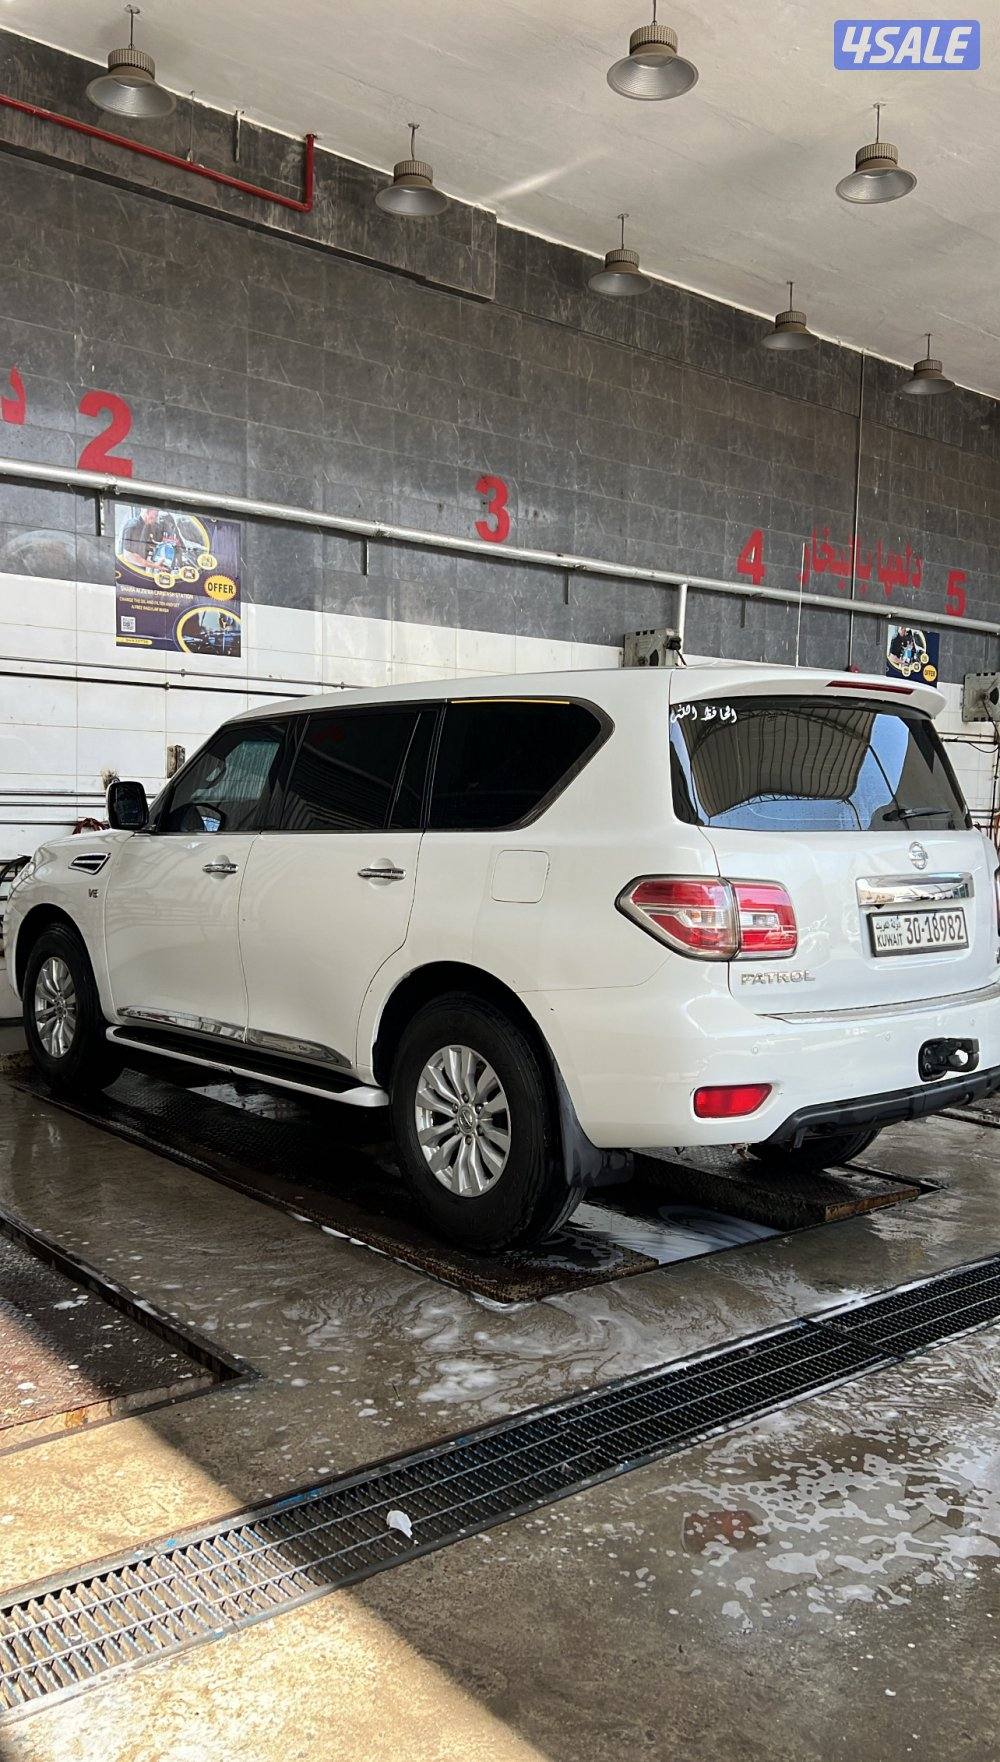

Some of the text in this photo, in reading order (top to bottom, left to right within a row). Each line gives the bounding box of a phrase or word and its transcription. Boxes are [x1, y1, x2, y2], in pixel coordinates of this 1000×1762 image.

[76, 388, 133, 479] 2
[475, 475, 510, 542] 3
[736, 528, 766, 585] 4
[207, 583, 234, 595] OFFER
[945, 568, 967, 617] 5
[876, 933, 903, 948] KUWAIT
[741, 969, 816, 986] PATROL
